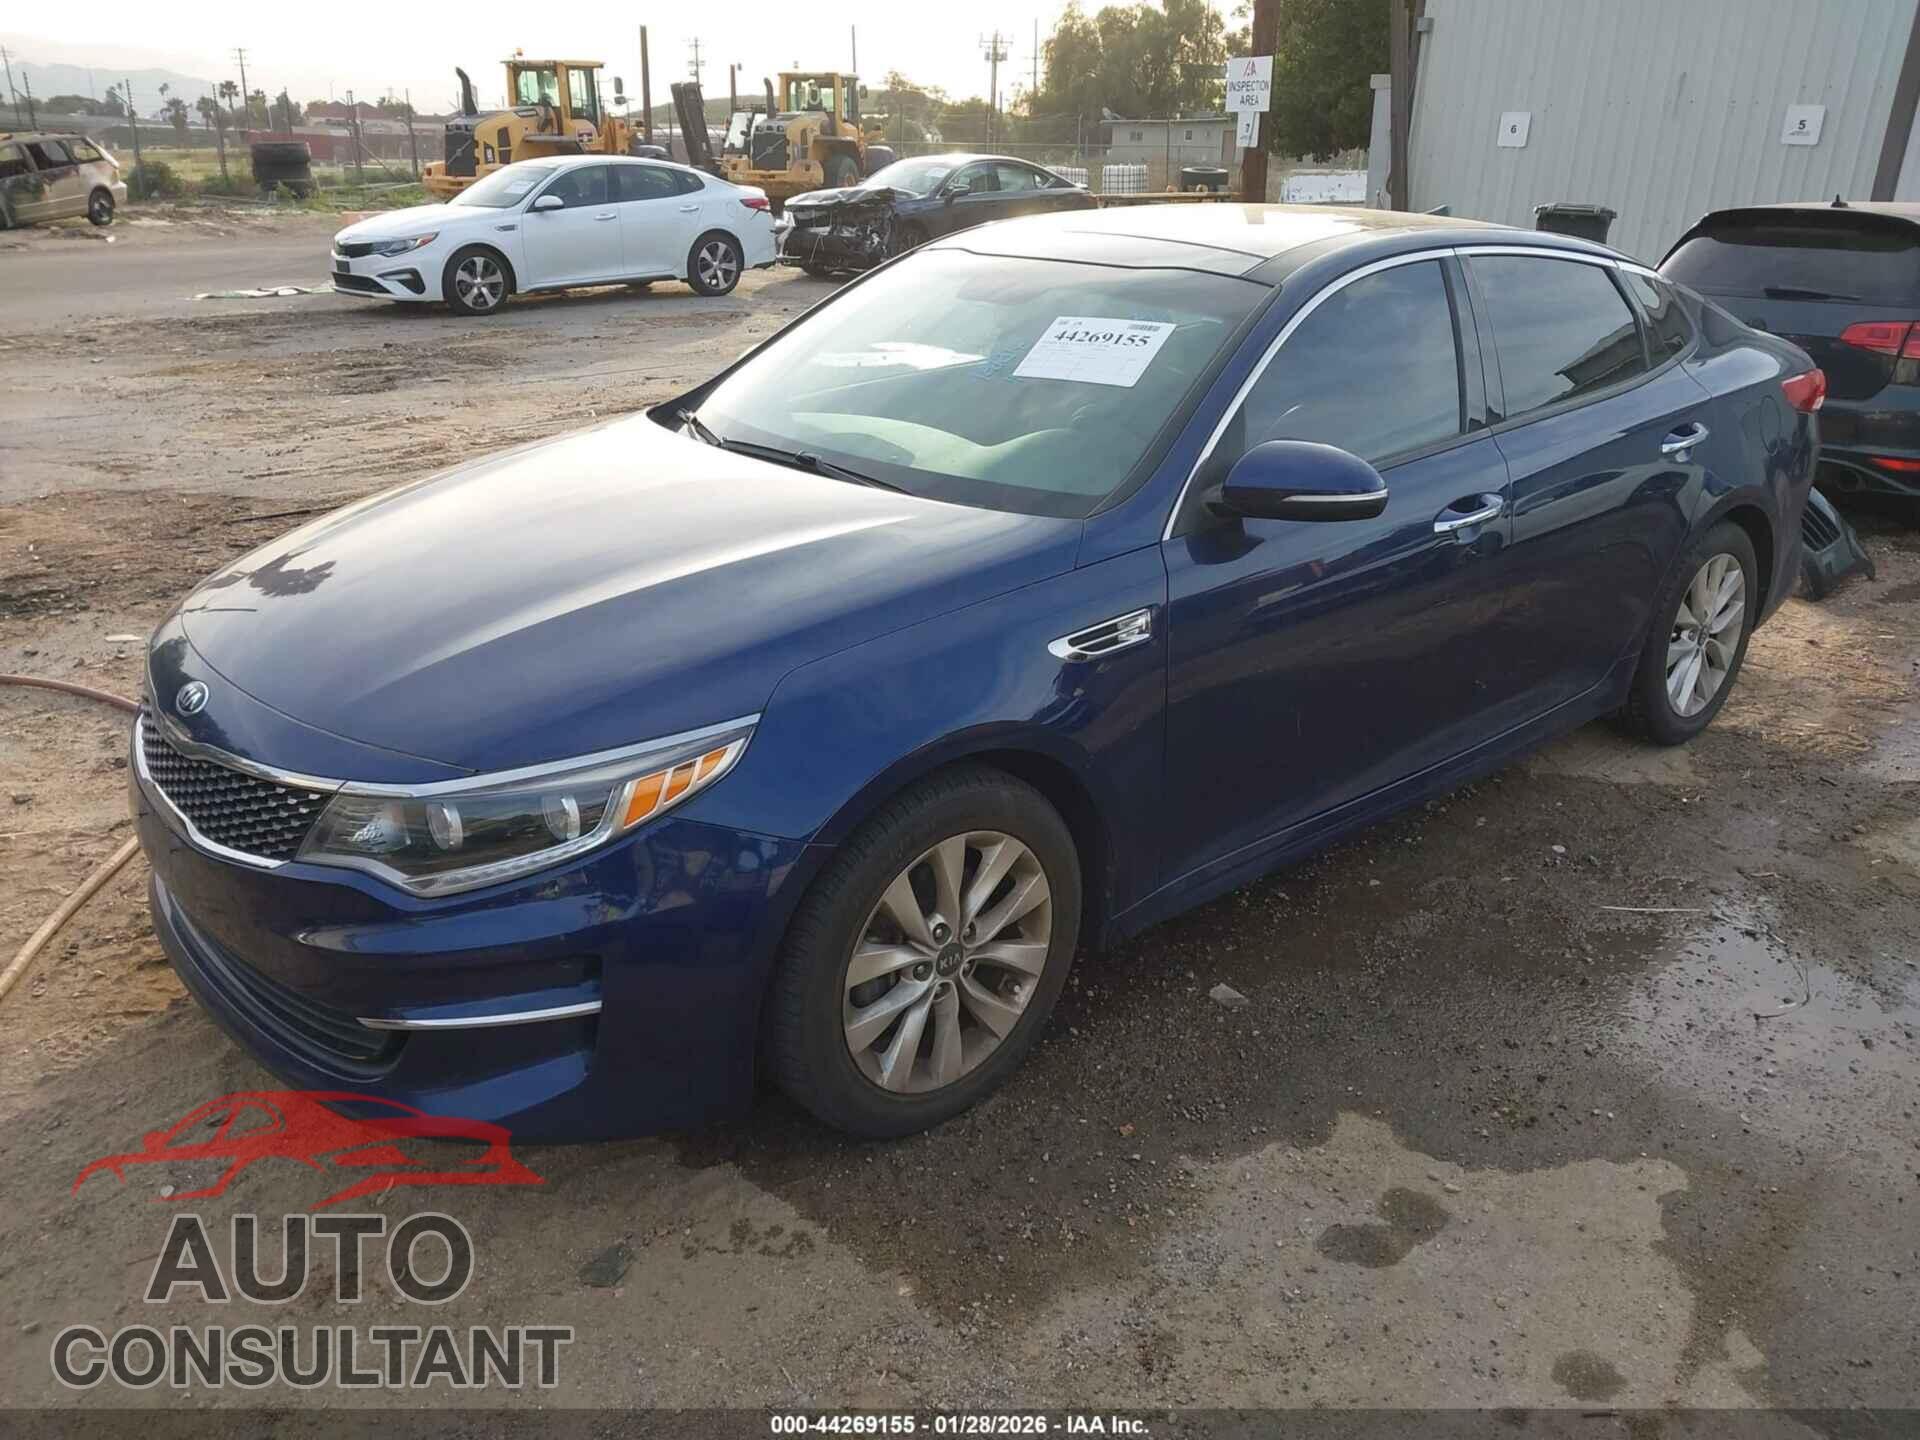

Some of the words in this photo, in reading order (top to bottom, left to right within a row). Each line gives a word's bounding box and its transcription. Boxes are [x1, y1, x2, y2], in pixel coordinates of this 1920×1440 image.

[1229, 80, 1269, 92] INSPECTION
[1239, 94, 1260, 106] AREA
[1510, 124, 1517, 134] 6
[1798, 119, 1807, 130] 5
[1053, 330, 1151, 348] 44269155
[940, 952, 961, 970] KIA
